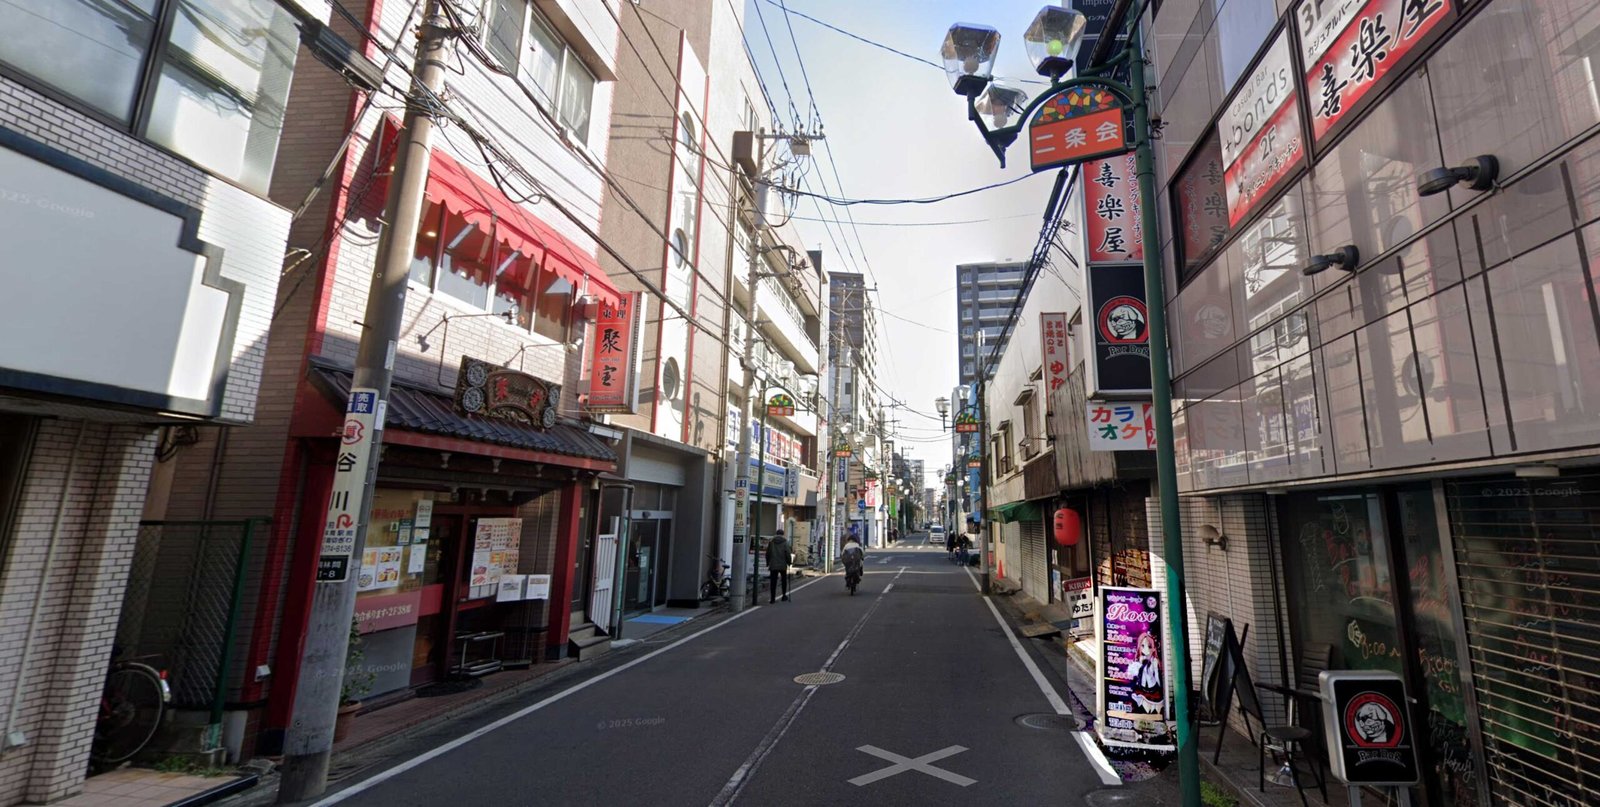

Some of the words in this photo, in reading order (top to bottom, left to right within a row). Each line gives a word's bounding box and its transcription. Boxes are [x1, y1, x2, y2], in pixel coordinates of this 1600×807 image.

[1233, 84, 1256, 117] Casual
[1256, 67, 1269, 87] Bar
[1036, 121, 1120, 154] 二条会
[1261, 125, 1277, 161] 2F
[1094, 163, 1127, 254] 喜楽屋
[1068, 581, 1091, 590] KIRIN
[1106, 603, 1158, 623] Rose
